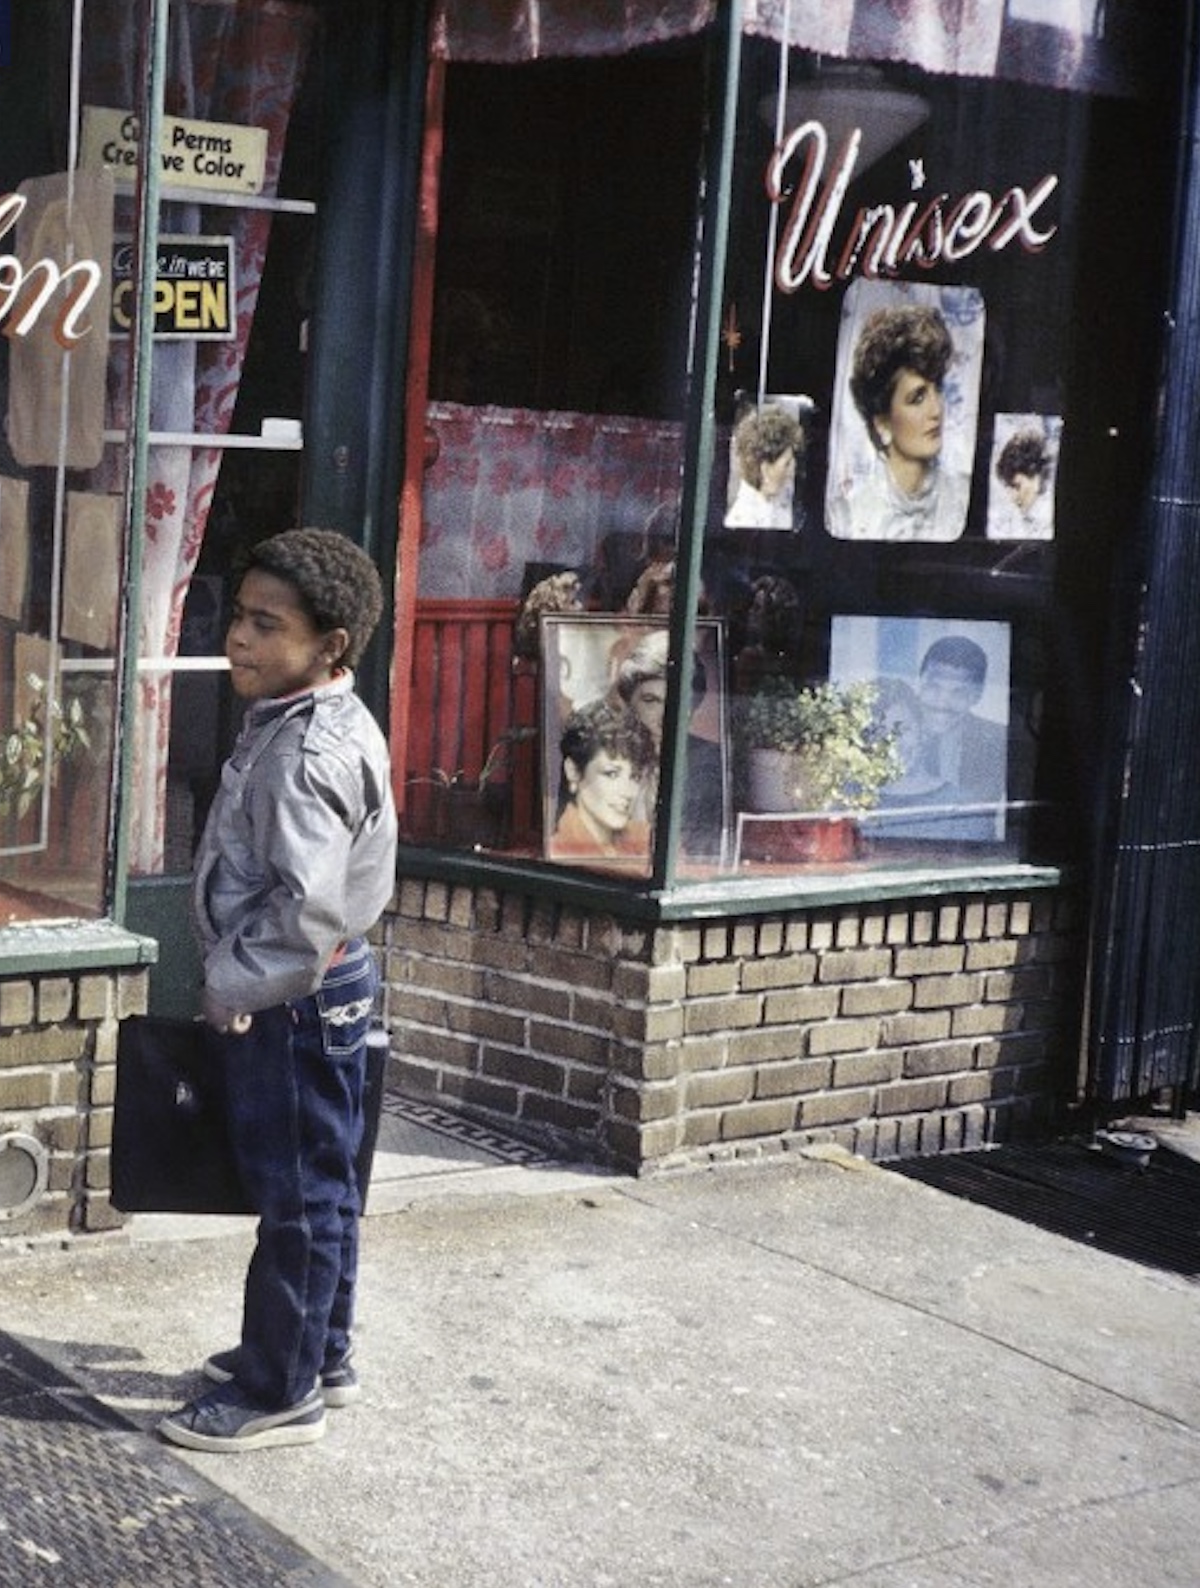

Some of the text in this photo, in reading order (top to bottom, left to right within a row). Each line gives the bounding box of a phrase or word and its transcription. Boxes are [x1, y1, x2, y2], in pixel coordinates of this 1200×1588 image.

[172, 126, 232, 153] Perms
[102, 142, 245, 177] Creve Color
[764, 120, 1059, 294] Unisex
[187, 256, 226, 278] WE'RE
